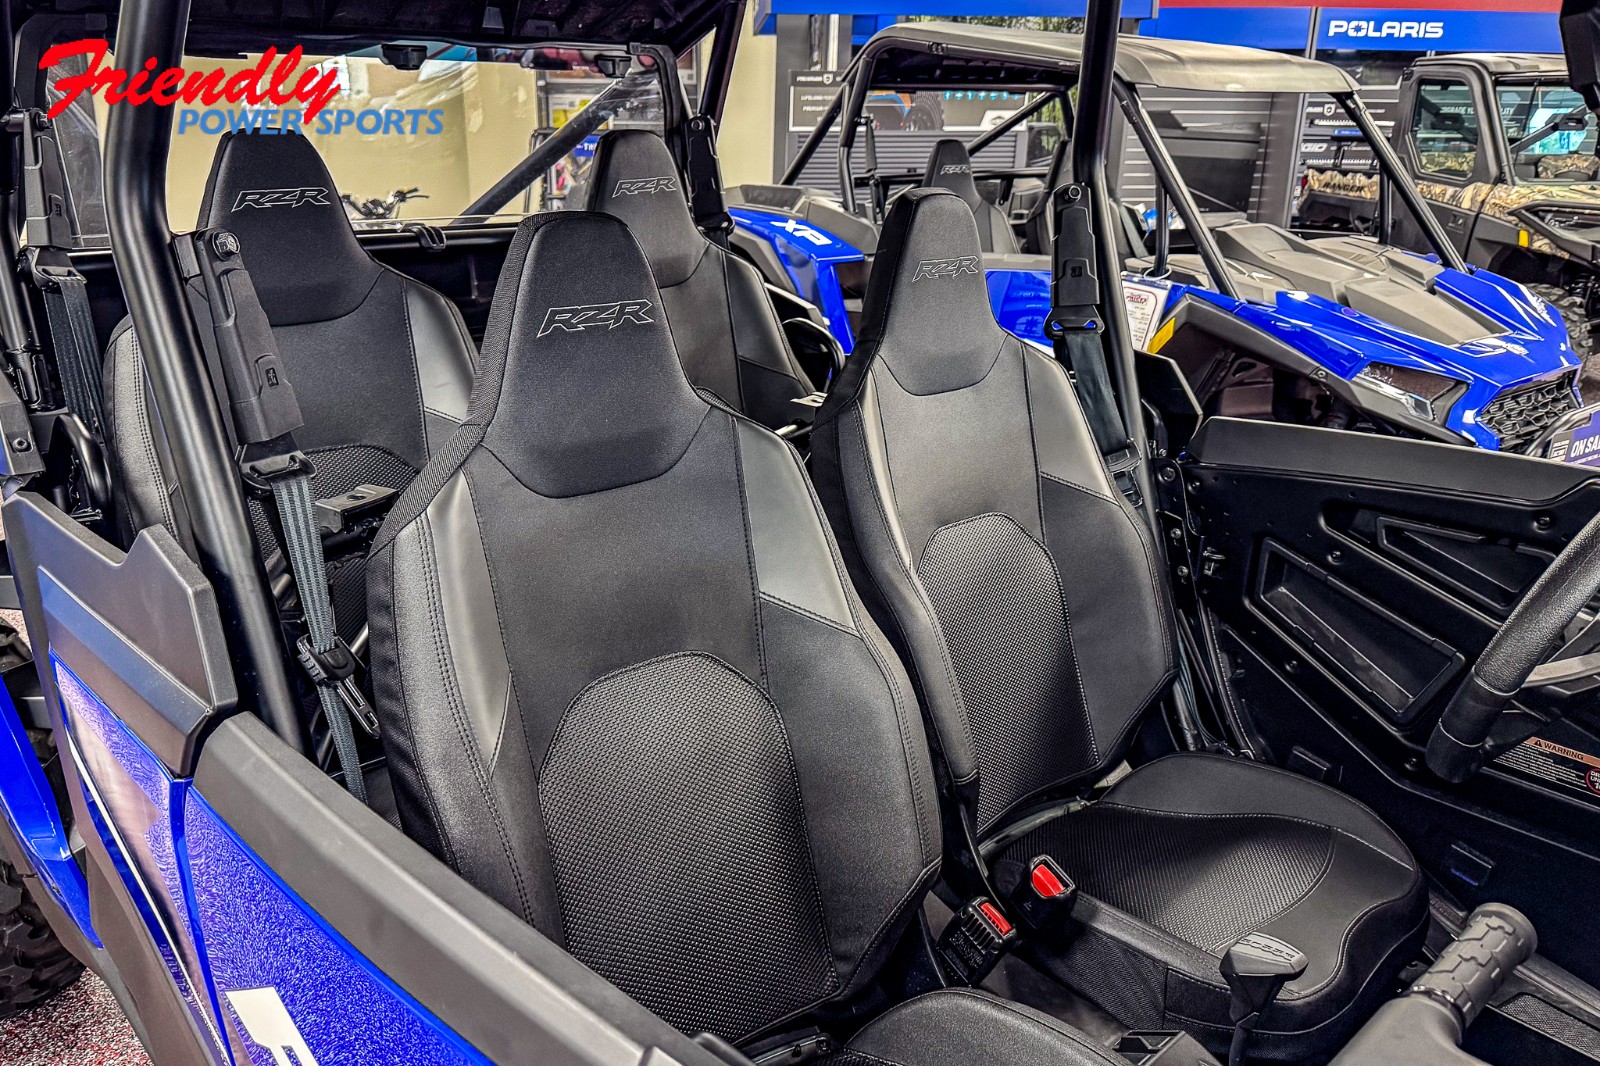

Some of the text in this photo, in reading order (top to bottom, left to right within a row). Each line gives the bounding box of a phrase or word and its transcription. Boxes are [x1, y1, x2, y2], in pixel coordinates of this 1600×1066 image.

[1327, 20, 1444, 38] POLARIS
[611, 176, 677, 198] RZR
[1322, 181, 1366, 193] RANGER
[231, 187, 331, 212] RZR
[769, 219, 833, 246] XP
[911, 255, 979, 283] RZR
[536, 299, 655, 338] RZR
[1570, 438, 1587, 457] ON
[1544, 742, 1585, 761] WARNING
